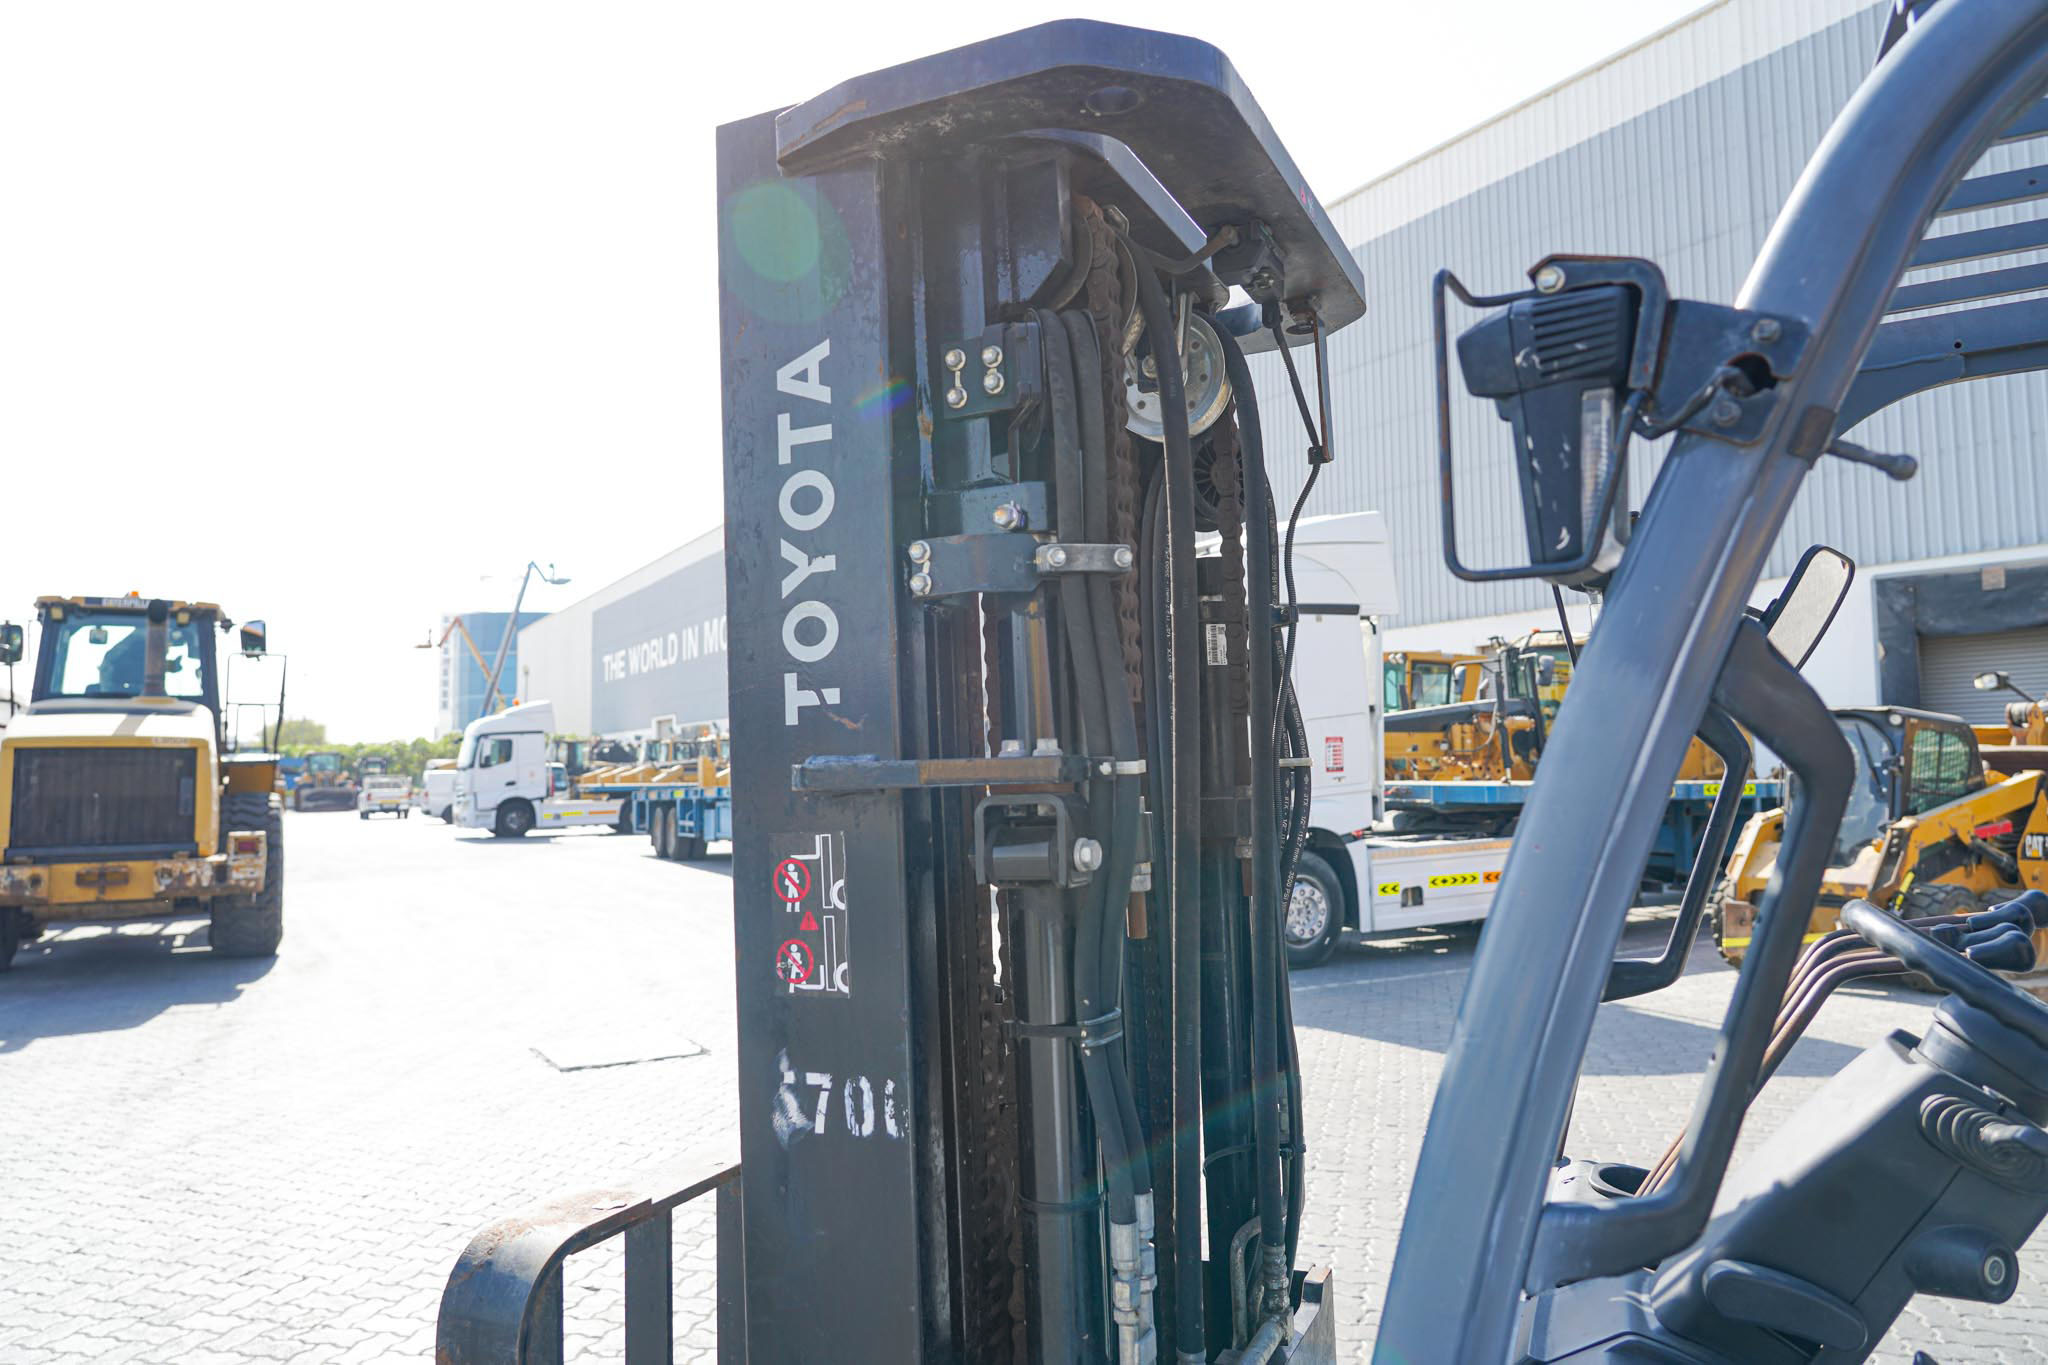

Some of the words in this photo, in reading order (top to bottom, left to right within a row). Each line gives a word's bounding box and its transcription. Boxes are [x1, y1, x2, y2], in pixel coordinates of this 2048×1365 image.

[776, 337, 841, 727] TOYOTA
[603, 649, 626, 682] THE
[628, 633, 679, 674] WORLD
[683, 625, 699, 660] IN
[2025, 835, 2044, 857] CAT
